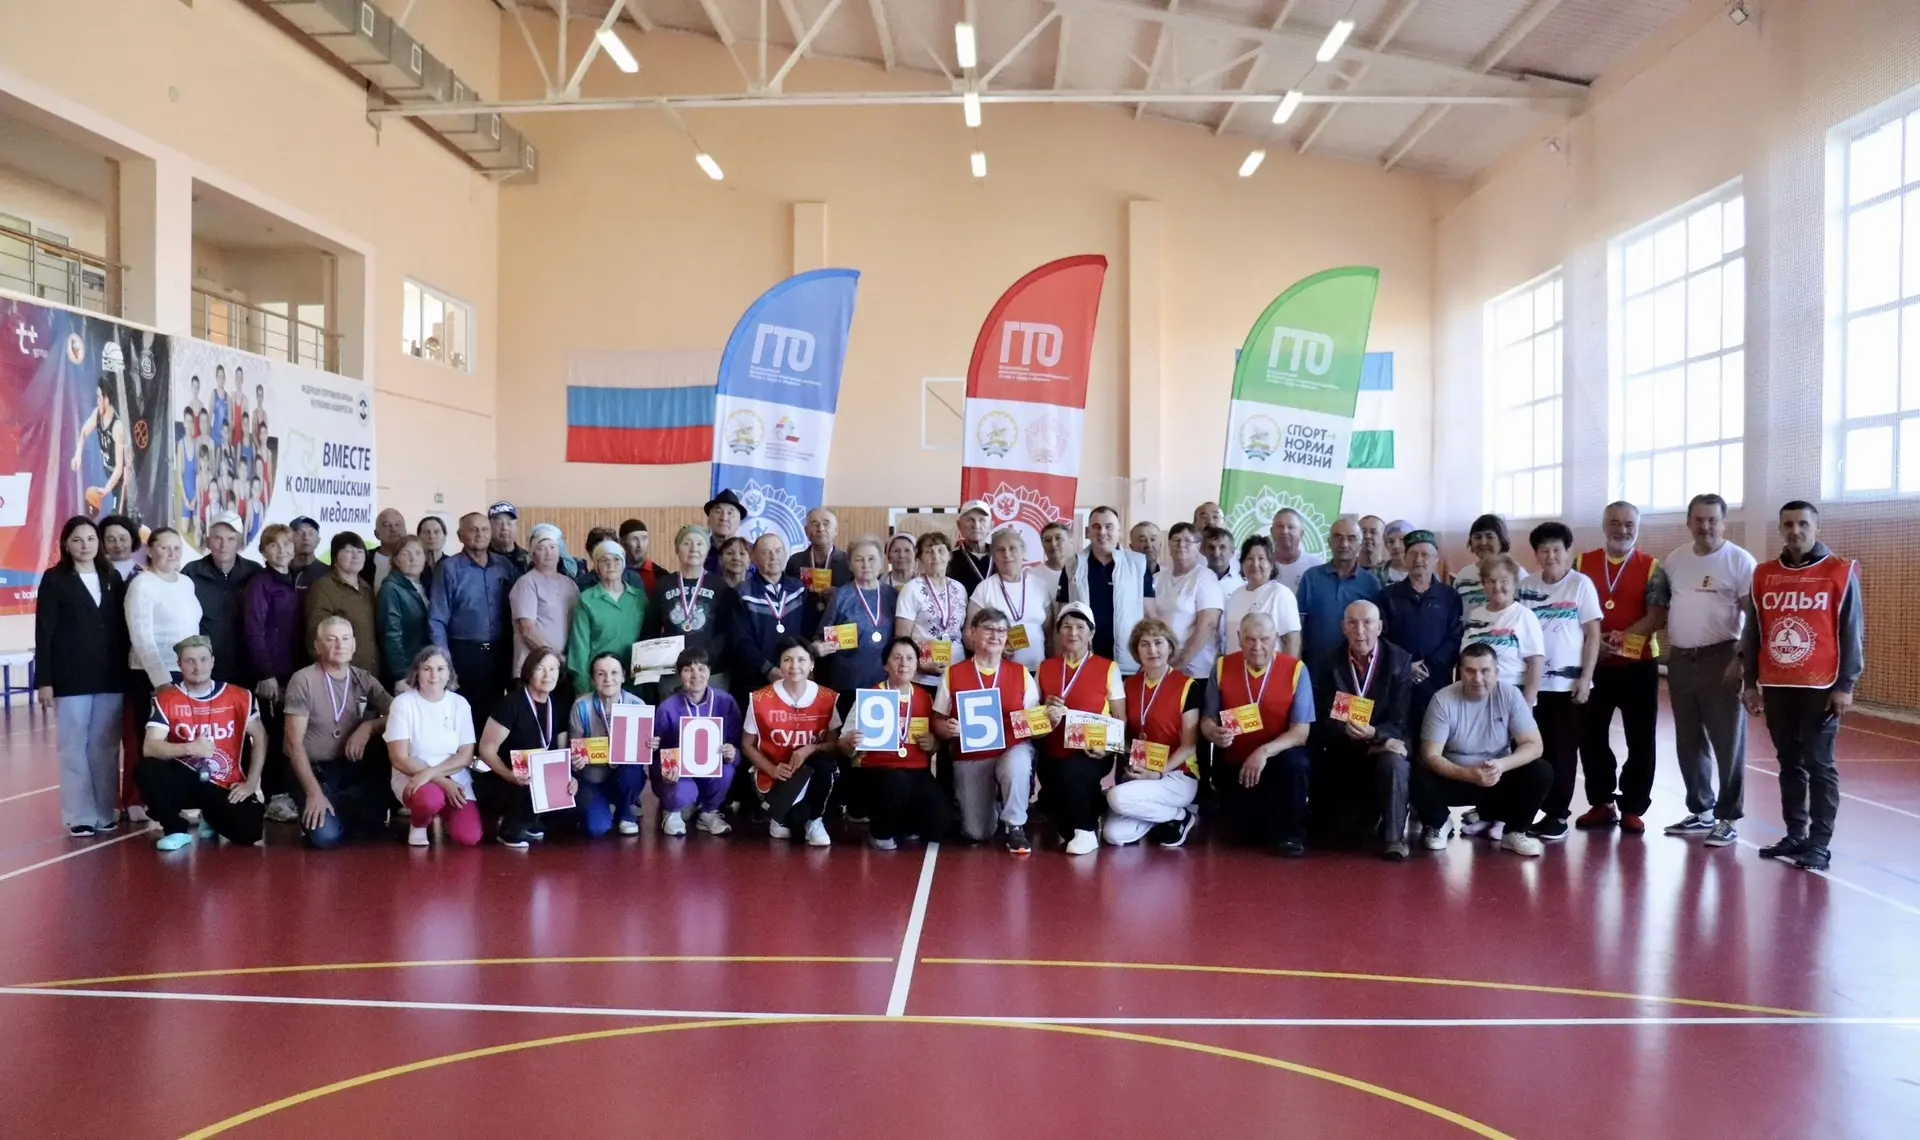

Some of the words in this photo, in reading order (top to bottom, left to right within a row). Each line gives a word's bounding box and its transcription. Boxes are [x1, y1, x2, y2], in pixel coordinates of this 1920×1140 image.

[751, 323, 816, 372] ГТО
[1000, 321, 1064, 367] ГТО
[1268, 326, 1334, 375] ГТО
[1287, 424, 1328, 441] СПОРТ
[323, 442, 371, 471] ВМЕСТЕ
[1284, 437, 1335, 456] НОРМА
[1282, 450, 1332, 469] ЖИЗНИ
[295, 475, 371, 497] олимпийским
[319, 501, 371, 523] медалям!
[1762, 591, 1829, 612] СУДЬЯ
[174, 704, 192, 717] ГТО
[769, 710, 787, 722] ГТО
[860, 696, 895, 747] 9
[175, 720, 235, 742] СУДЬЯ
[963, 696, 999, 748] 5
[612, 705, 654, 762] Т
[530, 752, 566, 811] Г
